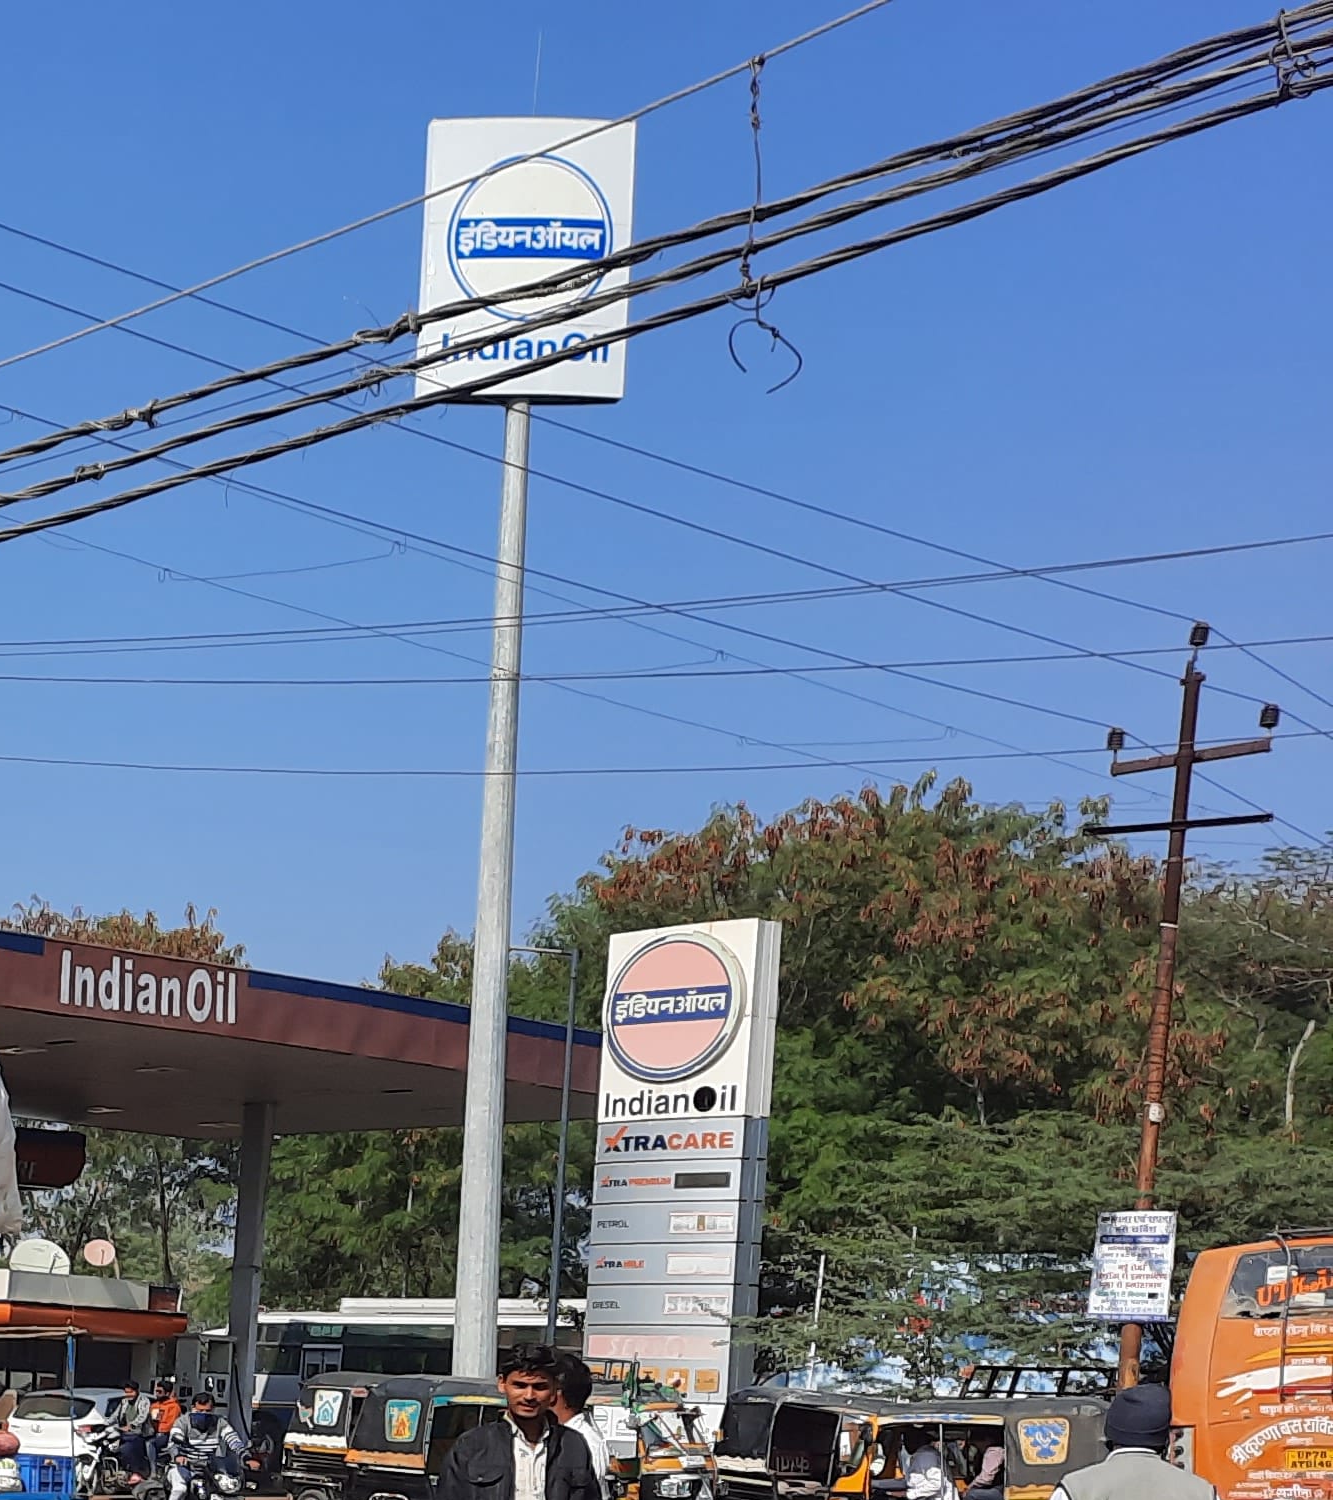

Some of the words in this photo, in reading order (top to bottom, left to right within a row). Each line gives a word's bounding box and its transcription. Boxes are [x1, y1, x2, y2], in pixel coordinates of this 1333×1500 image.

[458, 220, 603, 254] इंडियनऑयल
[59, 948, 238, 1025] IndianOil
[615, 989, 727, 1024] इंडियनऑयल
[604, 1084, 738, 1118] IndianOil
